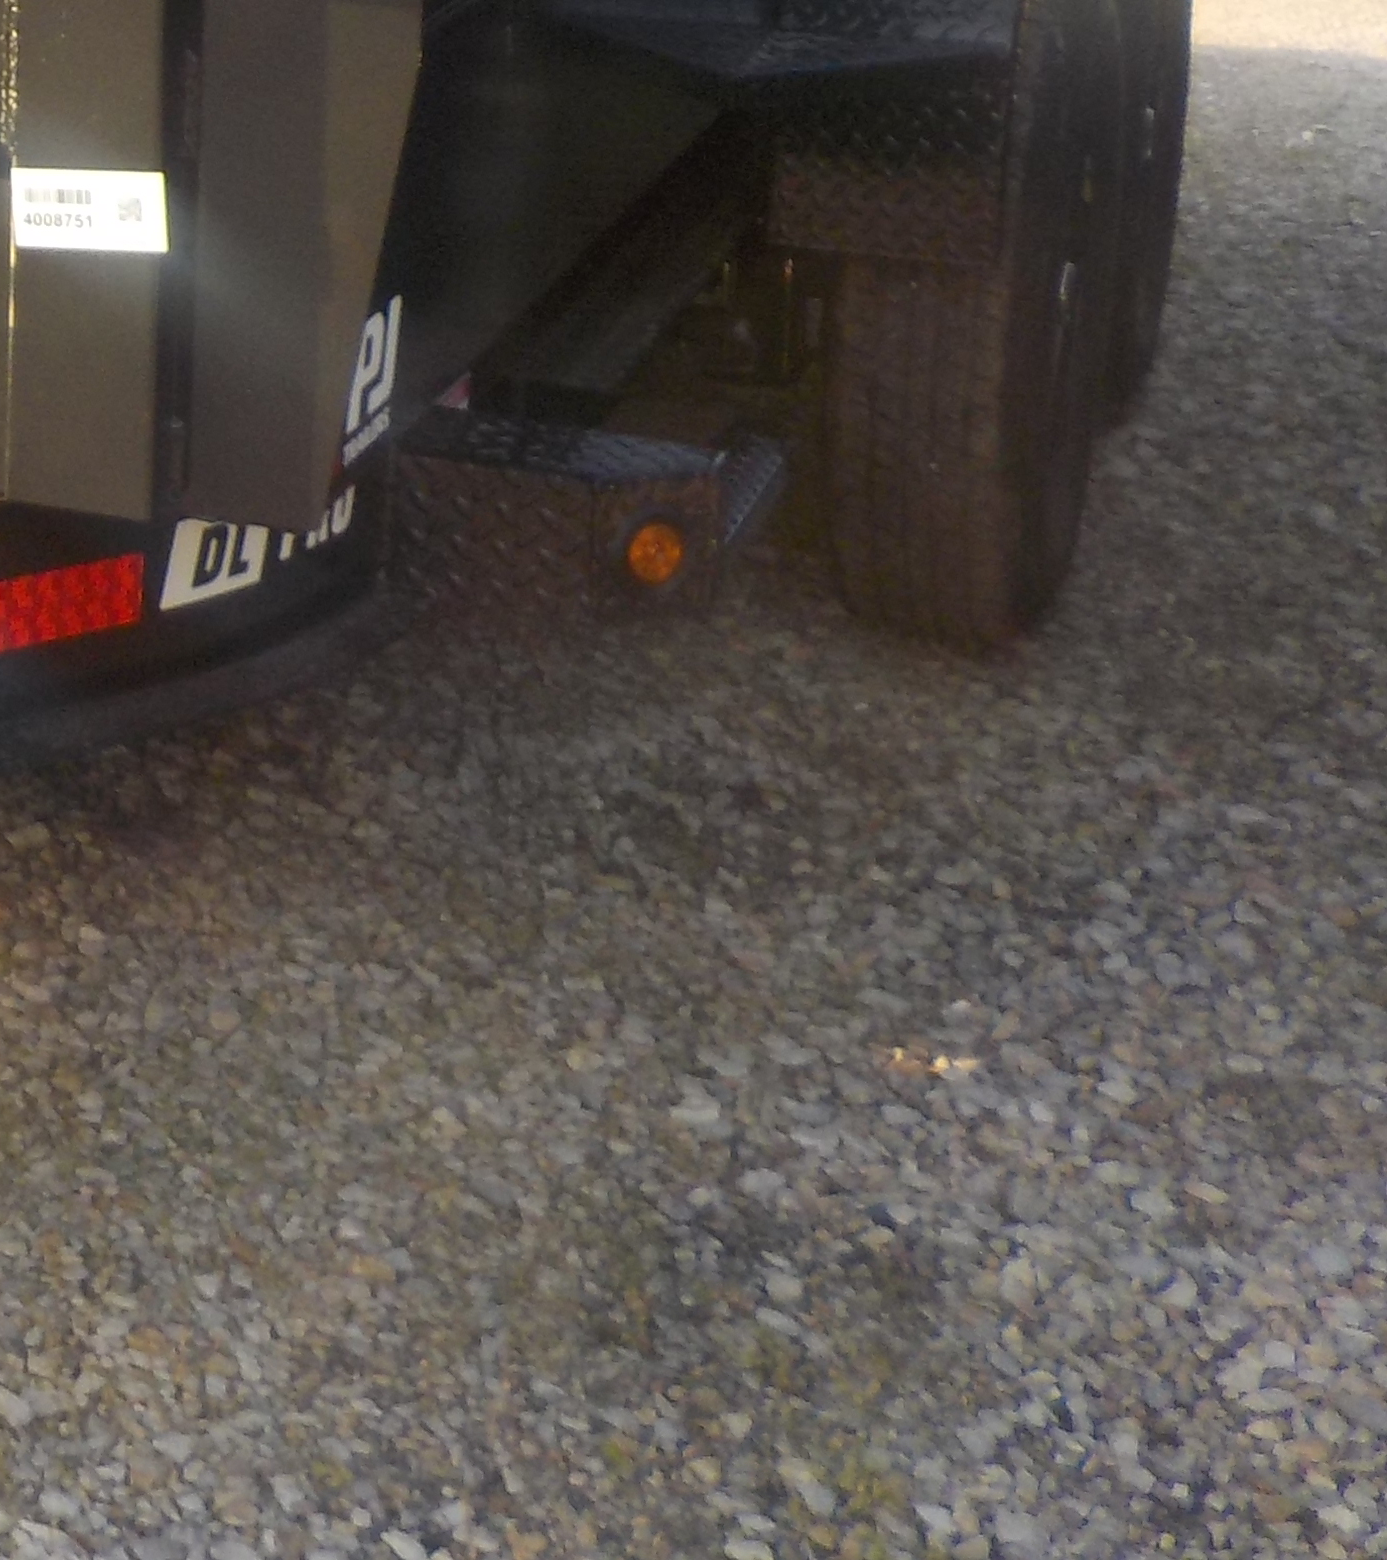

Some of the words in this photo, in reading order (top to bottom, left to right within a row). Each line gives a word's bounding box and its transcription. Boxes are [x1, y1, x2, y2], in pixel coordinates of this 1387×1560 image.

[23, 212, 93, 228] 4008751
[345, 294, 403, 435] PJ
[192, 519, 251, 590] DL
